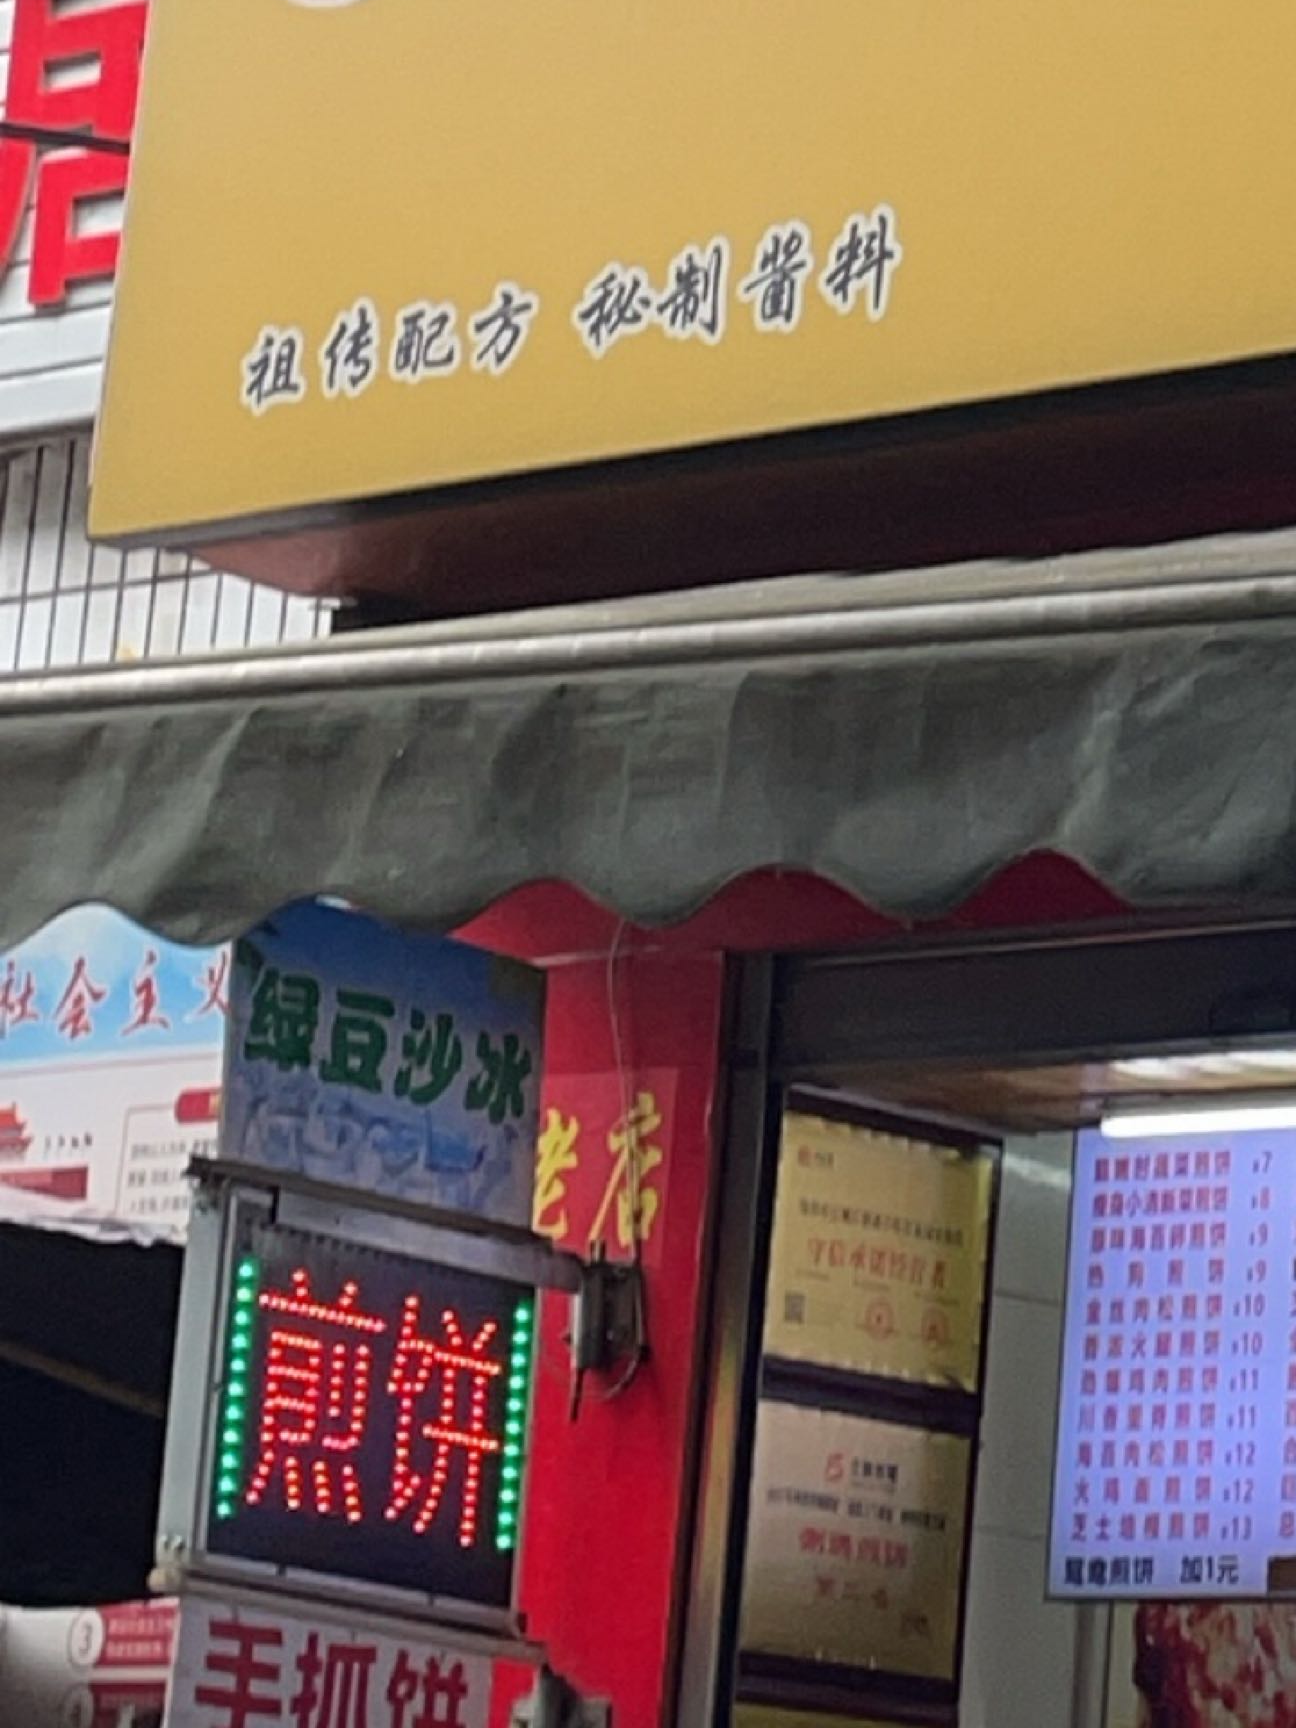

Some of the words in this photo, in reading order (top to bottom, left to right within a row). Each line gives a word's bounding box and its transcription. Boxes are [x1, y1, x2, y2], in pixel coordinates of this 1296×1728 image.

[242, 280, 540, 415] 祖传配方
[572, 203, 898, 358] 秘制酱料
[0, 949, 230, 1040] 社会主义
[244, 967, 532, 1124] 绿豆沙冰
[247, 1269, 502, 1547] 煎饼
[195, 1619, 468, 1728] 手抓饼
